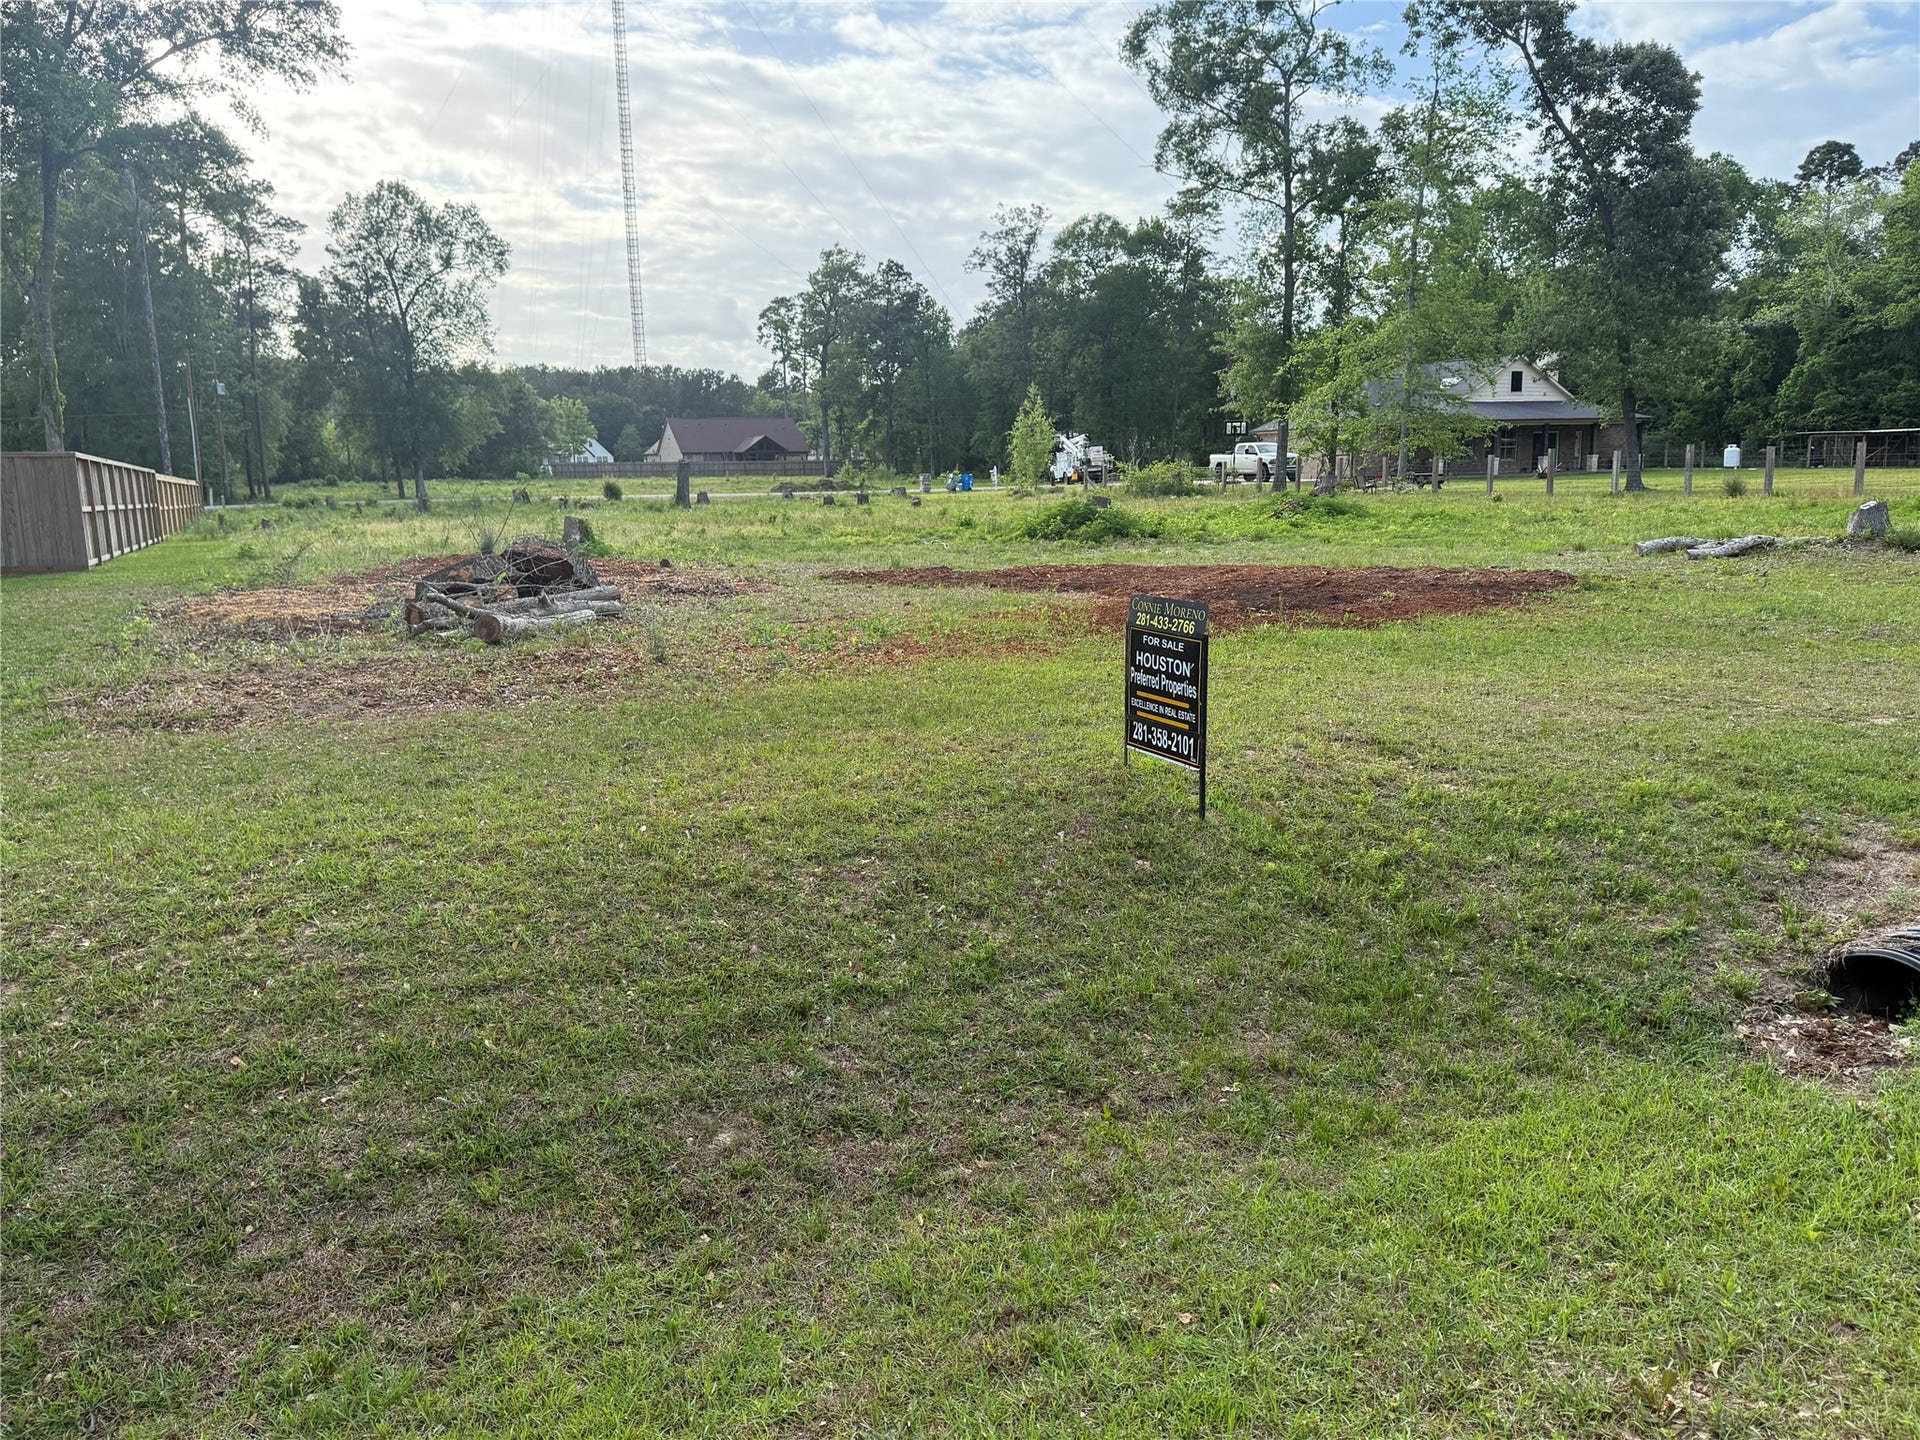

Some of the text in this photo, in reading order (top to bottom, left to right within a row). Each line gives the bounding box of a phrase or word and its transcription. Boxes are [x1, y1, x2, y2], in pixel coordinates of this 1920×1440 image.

[1131, 597, 1206, 621] CONNIE MORENO
[1136, 612, 1195, 634] 281-433-2766
[1142, 635, 1184, 652] FOR SALE
[1130, 667, 1197, 699] Preferred Properties
[1131, 697, 1196, 723] EXCELLENCE IN REAL ESTATE
[1132, 721, 1194, 757] 281-358-2101
